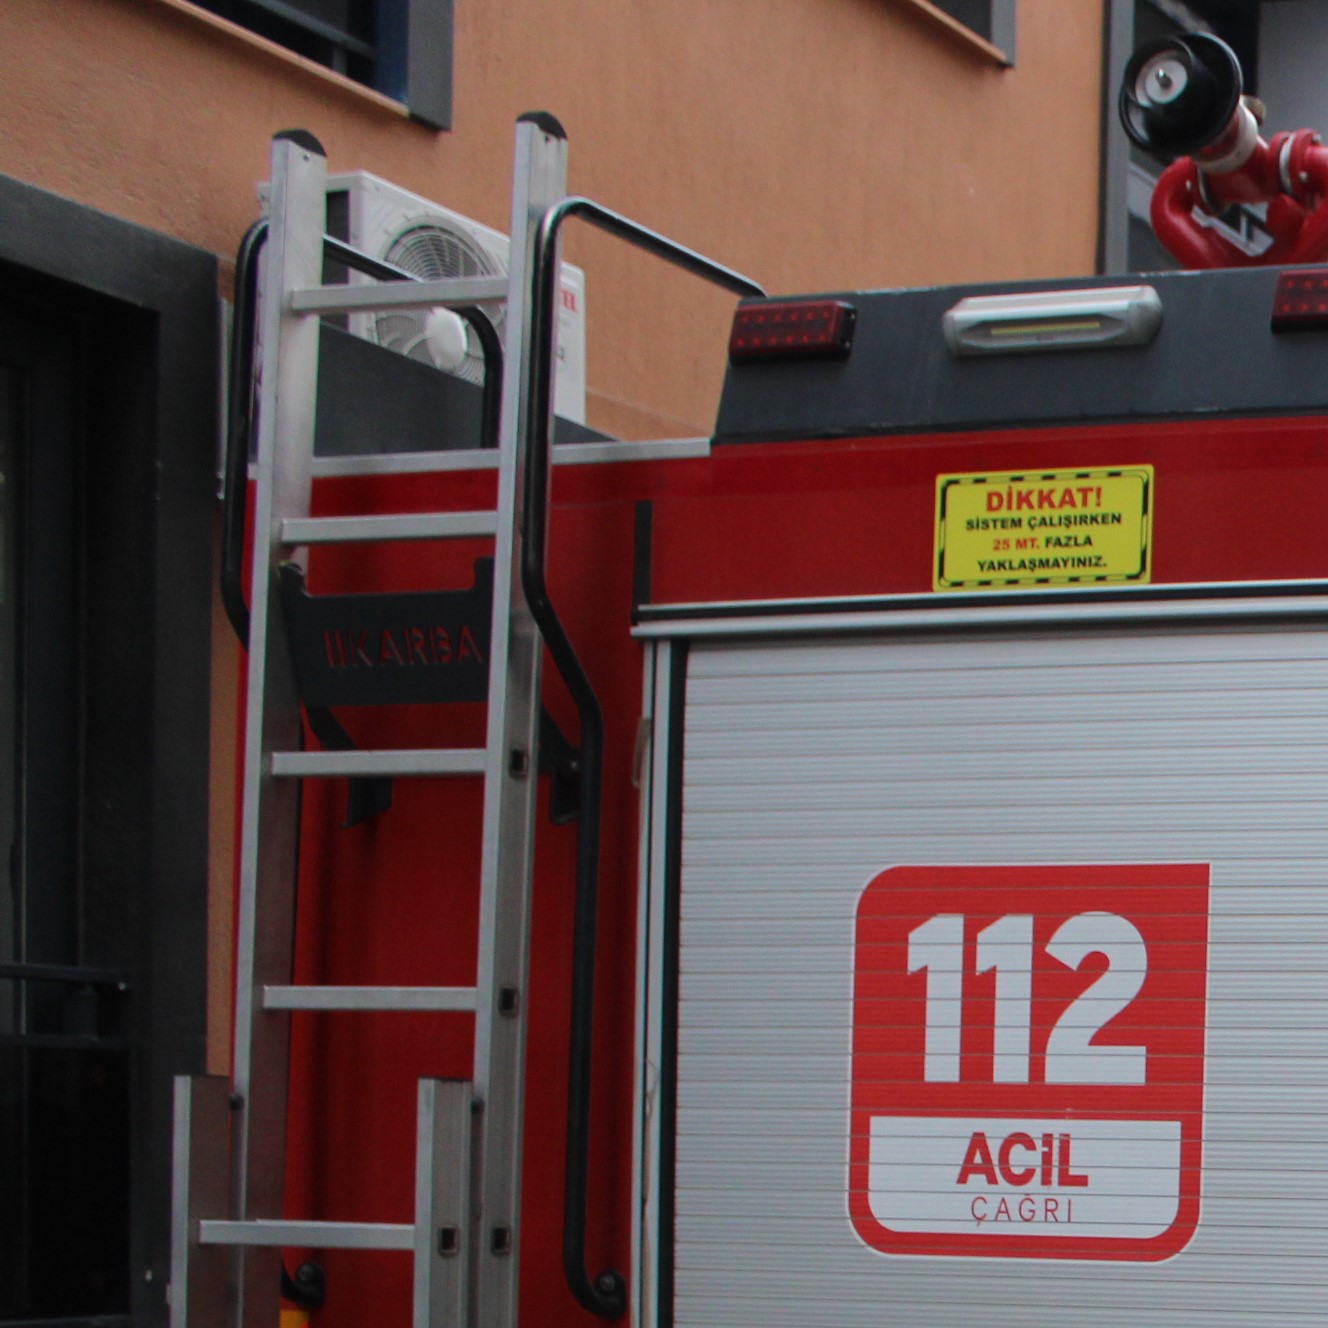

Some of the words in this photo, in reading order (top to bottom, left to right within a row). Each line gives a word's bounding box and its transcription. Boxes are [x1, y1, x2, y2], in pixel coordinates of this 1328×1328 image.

[986, 486, 1103, 513] DİKKAT!
[966, 515, 1023, 531] SİSTEM
[1028, 512, 1122, 531] ÇALIŞIRKEN
[993, 539, 1011, 551] 25
[1015, 537, 1040, 550] MT.
[1045, 535, 1093, 549] FAZLA
[977, 555, 1108, 573] YAKLAŞMAYINIZ.
[906, 910, 1149, 1087] 112
[956, 1131, 1089, 1188] ACİL
[970, 1193, 1073, 1228] ÇAĞRI
